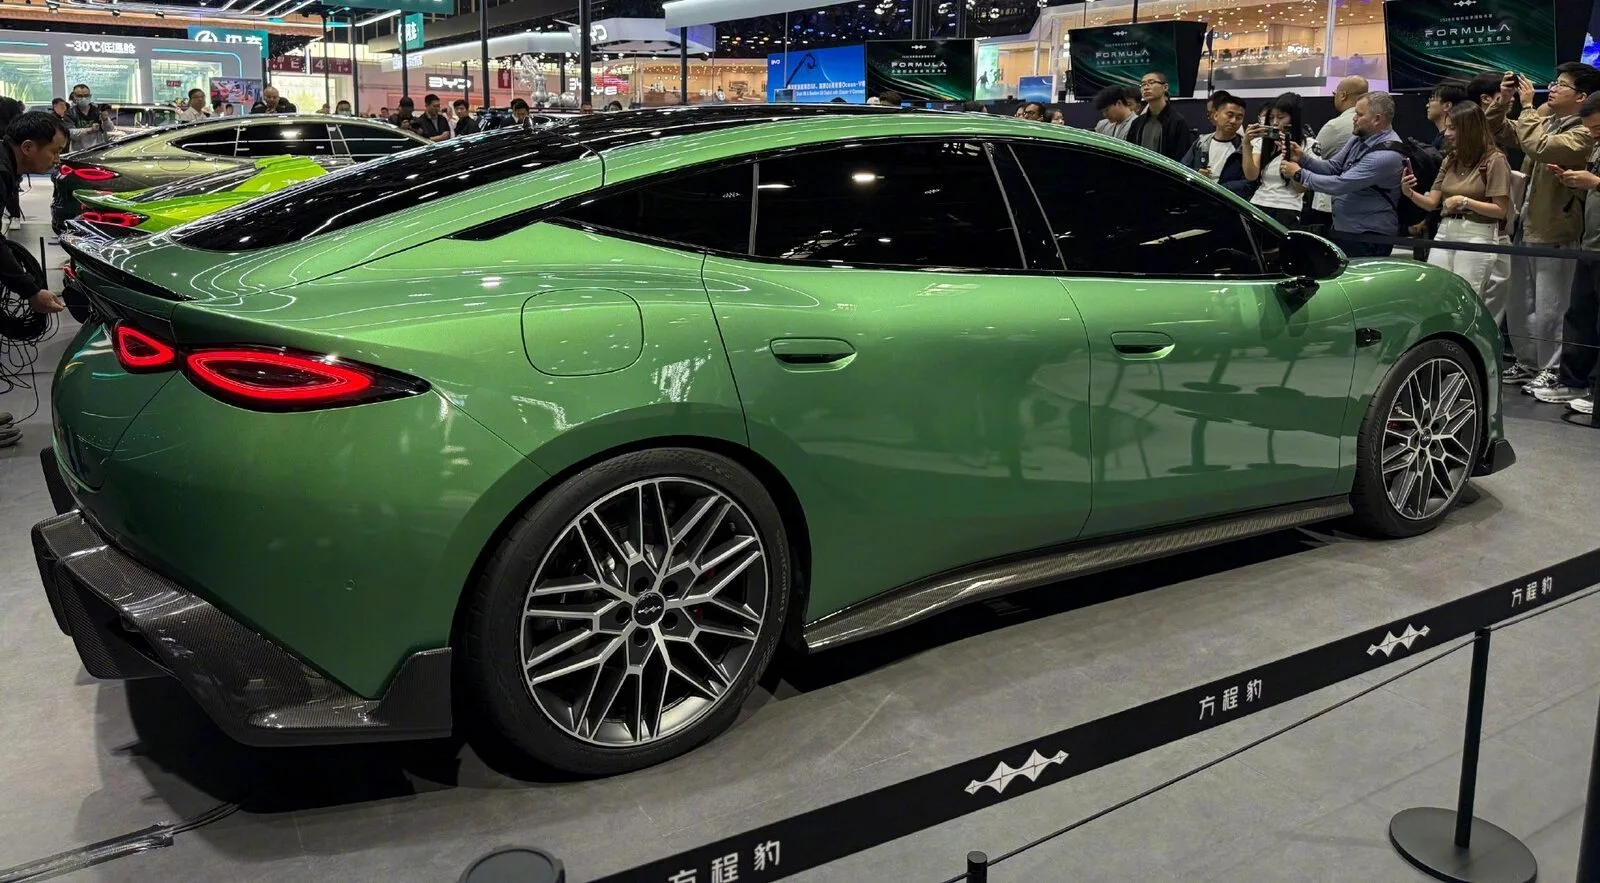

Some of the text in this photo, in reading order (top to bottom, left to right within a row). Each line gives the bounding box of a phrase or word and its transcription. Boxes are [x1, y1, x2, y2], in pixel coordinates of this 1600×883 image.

[1425, 24, 1510, 37] FORMULA
[1095, 49, 1149, 58] FORMULA
[428, 76, 472, 90] BYD
[1511, 576, 1553, 607] 方程豹
[1199, 679, 1262, 720] 方程豹
